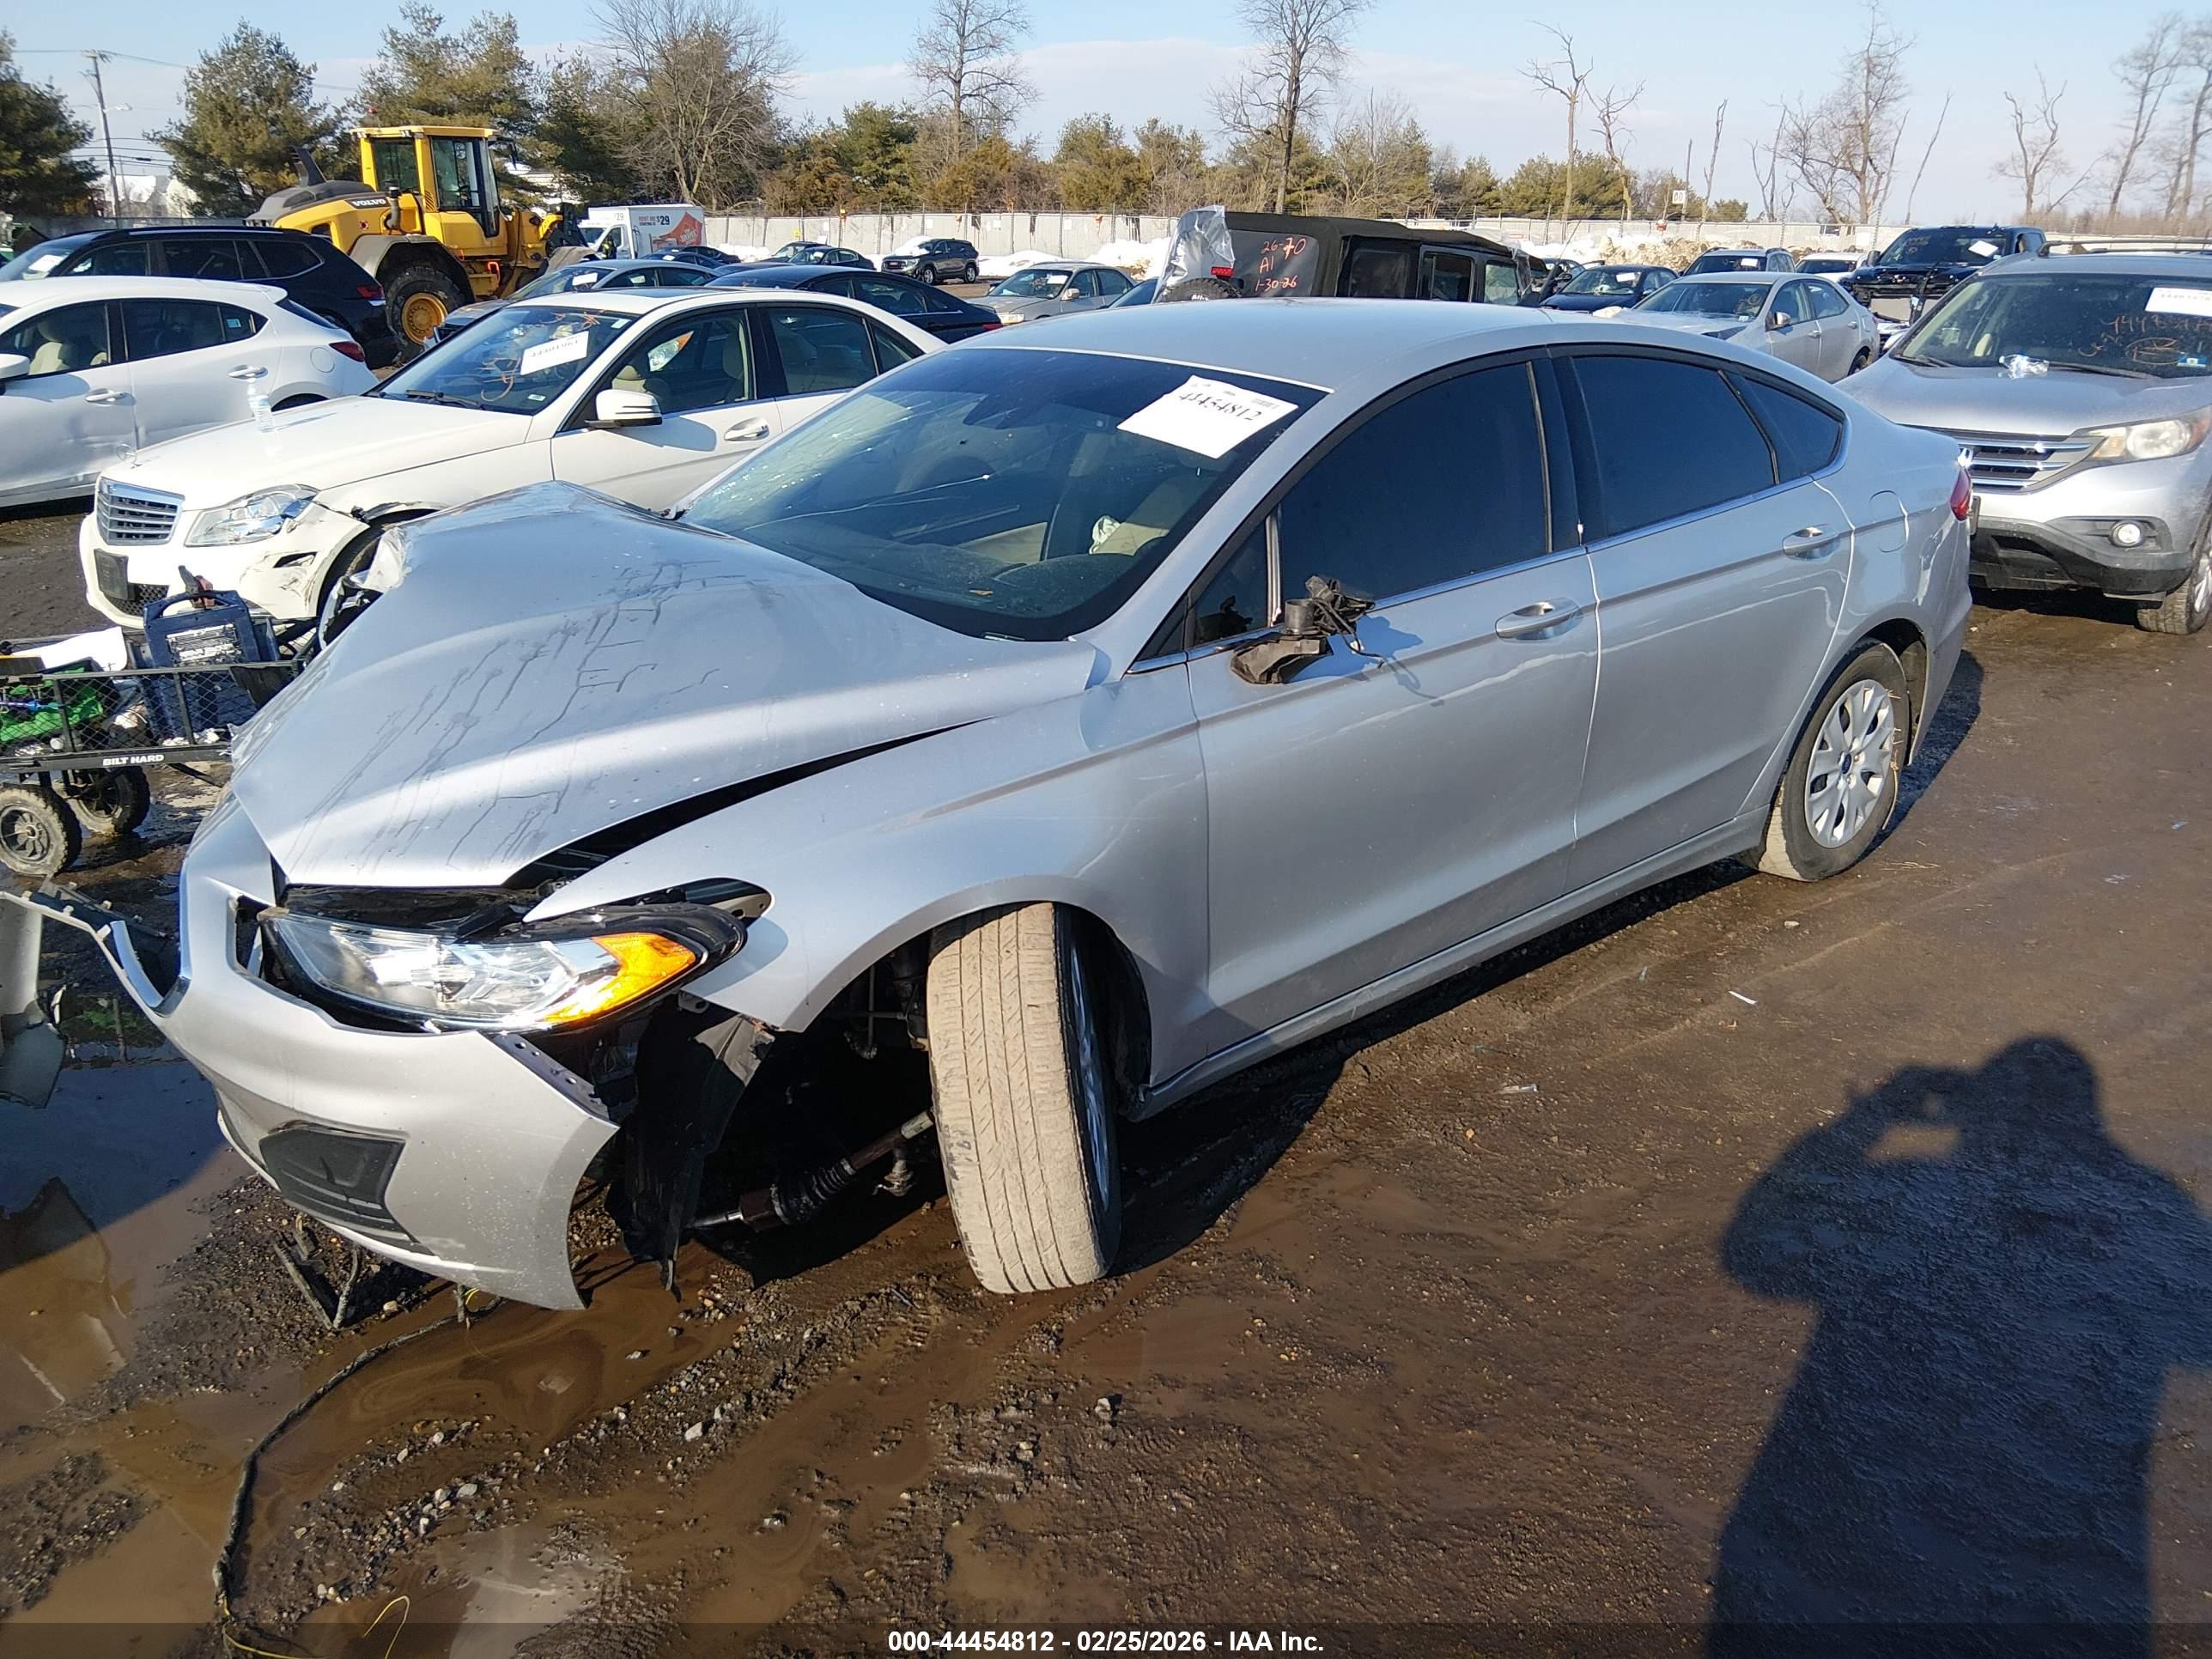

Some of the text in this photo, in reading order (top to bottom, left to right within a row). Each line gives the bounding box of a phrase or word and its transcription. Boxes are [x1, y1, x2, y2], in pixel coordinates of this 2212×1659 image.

[351, 198, 386, 207] VOLVO
[103, 754, 165, 766] BILT HARD
